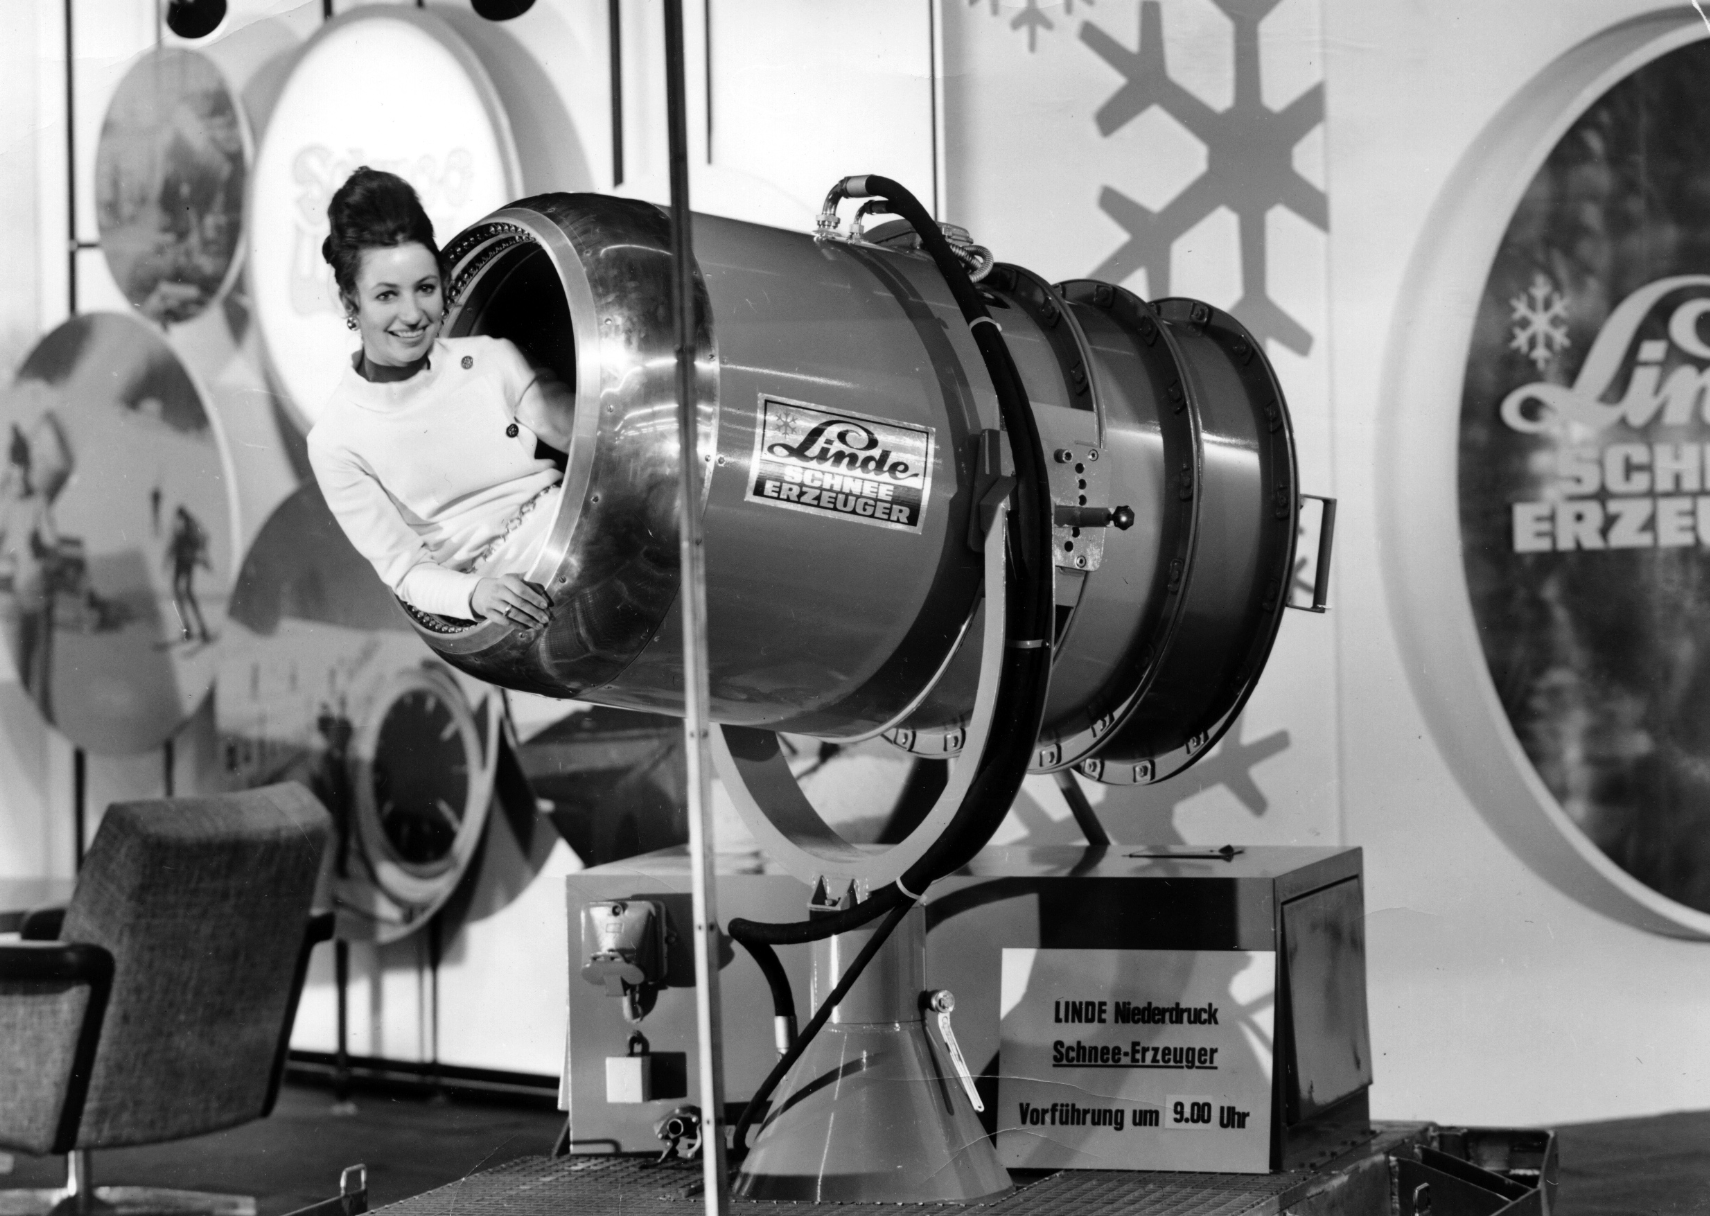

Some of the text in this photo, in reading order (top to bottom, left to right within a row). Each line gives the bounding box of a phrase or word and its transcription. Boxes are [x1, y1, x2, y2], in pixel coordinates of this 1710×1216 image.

[767, 420, 919, 480] Linde
[1555, 443, 1710, 496] SCH
[763, 479, 911, 524] ERZEUGER
[783, 465, 894, 502] SCHNEE
[1512, 498, 1710, 553] ERZE
[1054, 1000, 1219, 1025] LINDE Niederdruck
[1052, 1040, 1218, 1069] Schnee-Erzeuger
[1019, 1101, 1250, 1131] Vorführung um 9.00 Uhr
